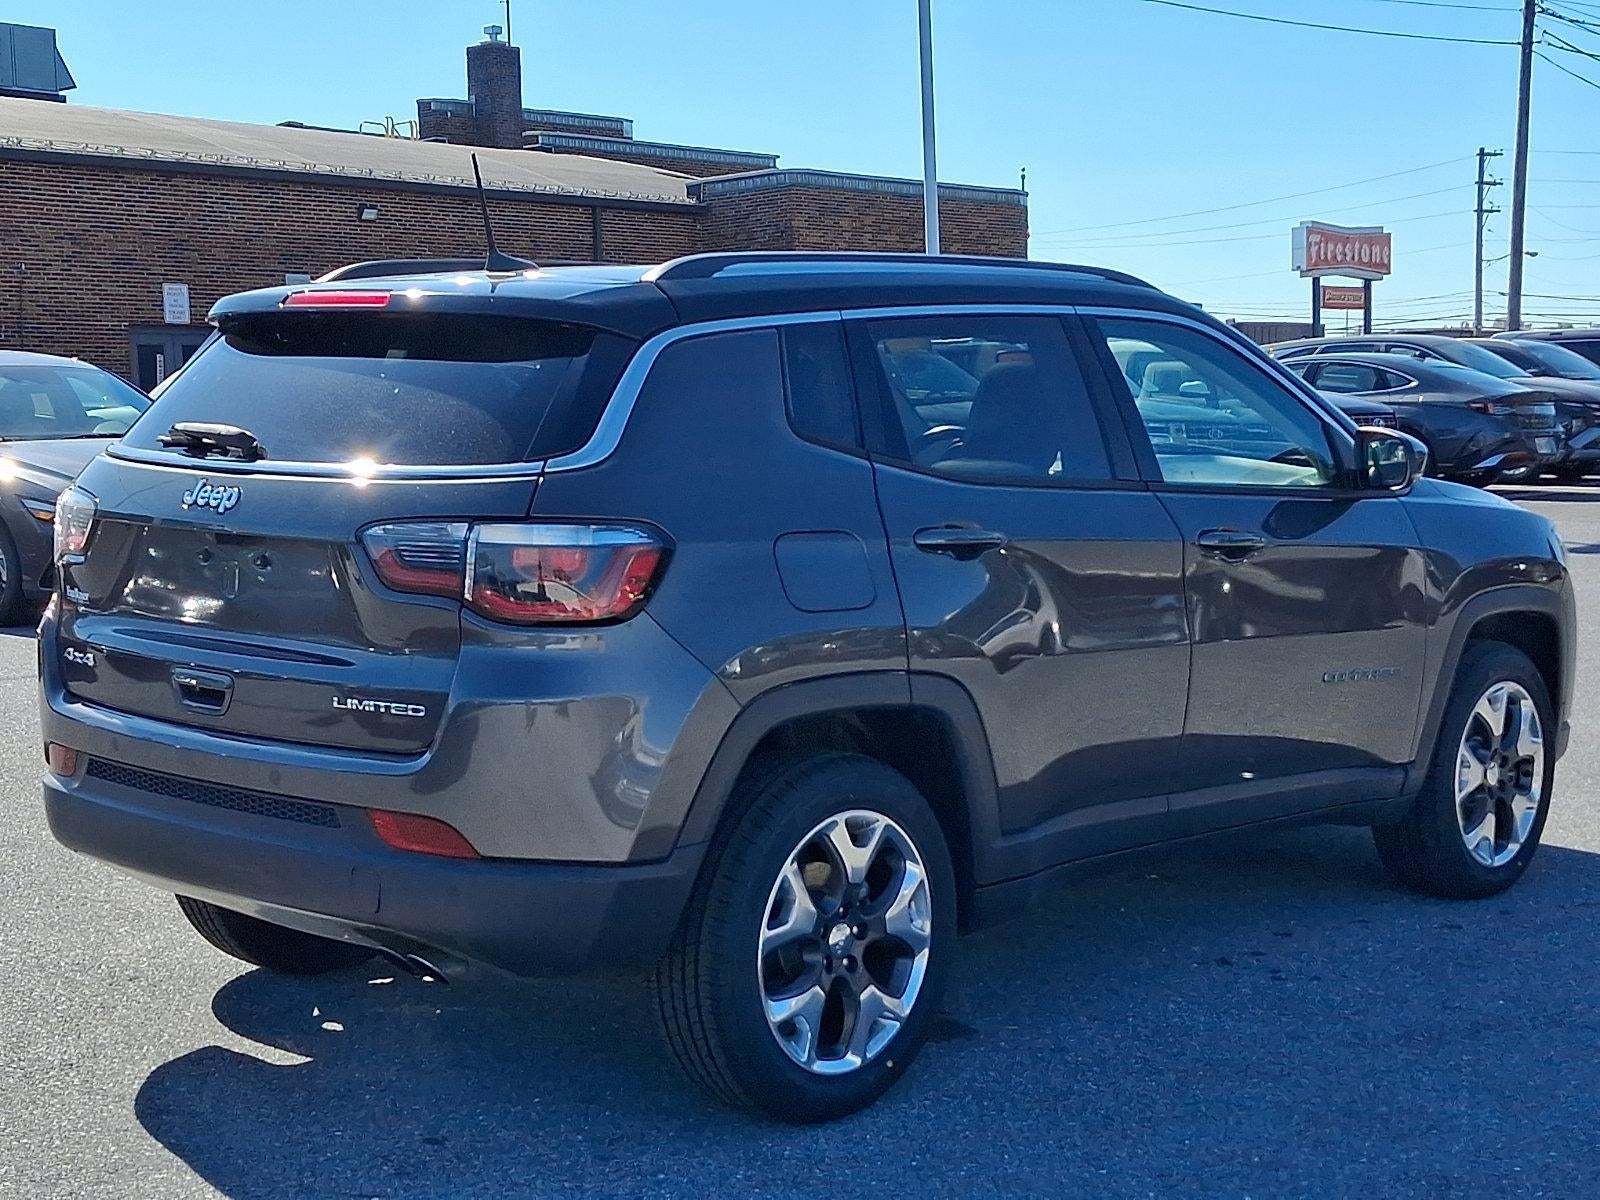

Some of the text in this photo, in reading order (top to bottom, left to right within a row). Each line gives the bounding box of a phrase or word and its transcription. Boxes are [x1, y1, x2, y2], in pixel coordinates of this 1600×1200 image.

[1308, 234, 1390, 265] Firestone
[182, 478, 240, 513] Jeep
[64, 647, 95, 667] 4x4
[332, 696, 426, 717] LIMITED
